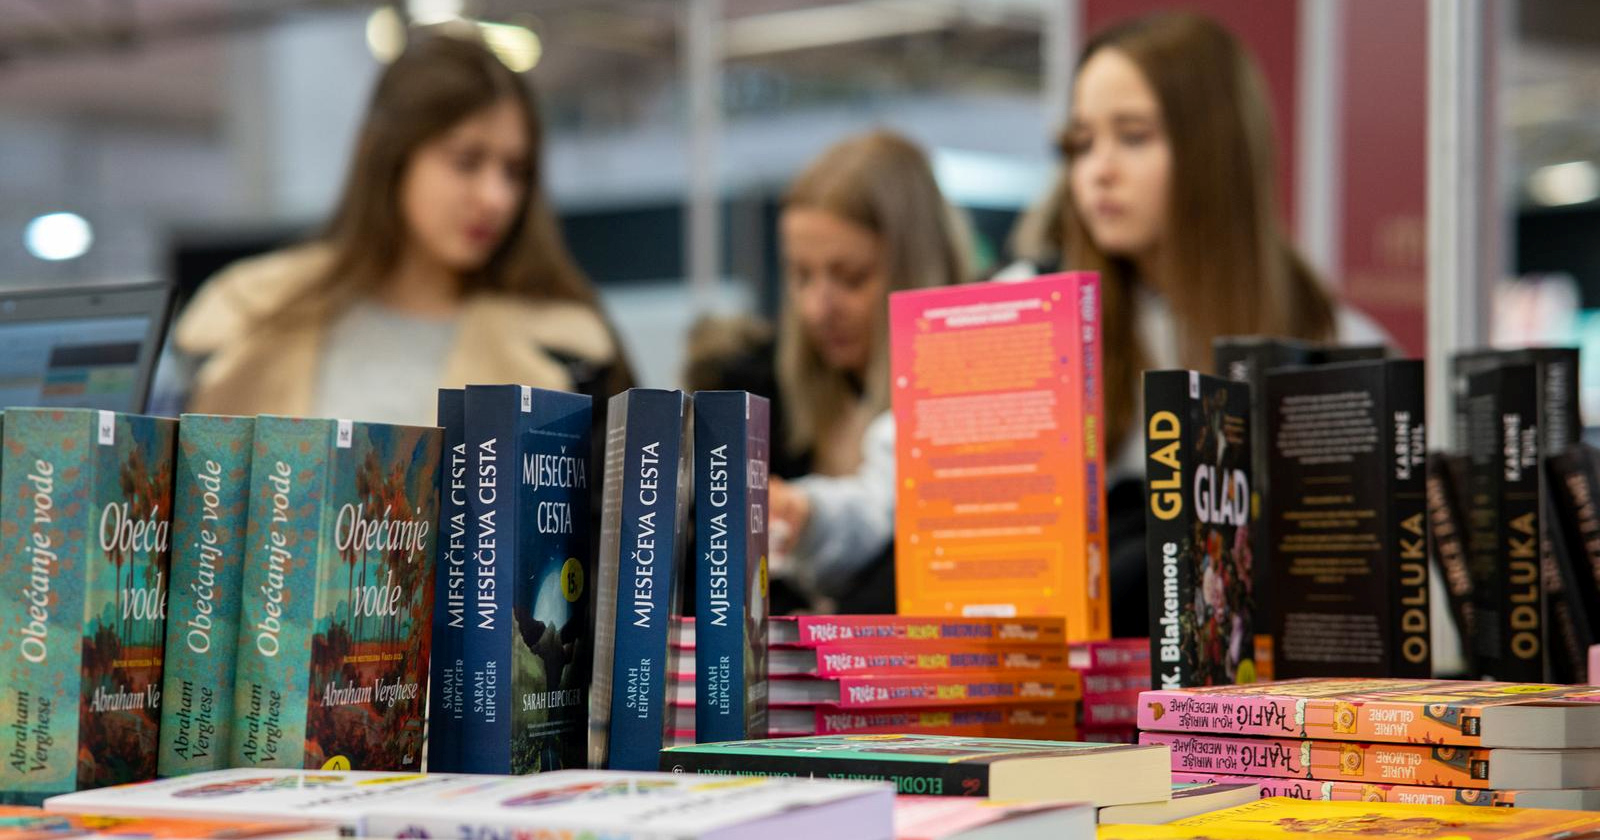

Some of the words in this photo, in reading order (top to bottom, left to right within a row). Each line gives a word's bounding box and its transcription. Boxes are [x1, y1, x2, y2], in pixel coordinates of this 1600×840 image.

[479, 438, 497, 505] CESTA
[522, 446, 587, 492] MJESEČEVA
[1149, 410, 1183, 521] GLAD
[1394, 410, 1411, 480] KARINE
[1503, 413, 1521, 481] KARINE
[27, 458, 54, 523] vode
[197, 459, 222, 525] vode
[267, 460, 292, 527] vode
[639, 441, 661, 507] CESTA
[710, 444, 728, 507] CESTA
[1193, 463, 1249, 526] GLAD
[99, 501, 168, 552] Obeća
[334, 502, 429, 563] Obećanje
[537, 501, 573, 536] CESTA
[21, 529, 58, 663] Obećanje
[186, 529, 223, 655] Obećanje
[256, 531, 292, 658] Obećanje
[354, 570, 401, 618] vode
[472, 510, 499, 630] MJESEČEVA
[631, 511, 657, 628] MJESEČEVA
[705, 512, 730, 627] MJESEČEVA
[1400, 513, 1427, 663] ODLUKA
[1508, 512, 1539, 659] ODLUKA
[1159, 541, 1180, 662] Blakemore
[840, 626, 853, 639] ZA
[442, 668, 454, 710] SARAH
[626, 667, 639, 709] SARAH
[638, 658, 652, 719] LEIPCIGER
[708, 665, 719, 707] SARAH
[719, 655, 731, 716] LEIPCIGER
[854, 656, 867, 668] ZA
[89, 685, 144, 713] Abraham
[320, 681, 371, 708] Abraham
[374, 676, 418, 708] Verghese
[473, 671, 485, 713] SARAH
[485, 660, 497, 723] LEIPCIGER
[522, 691, 546, 712] SARAH
[547, 688, 581, 708] LEIPCIGER
[877, 688, 889, 699] ZA
[1169, 698, 1218, 713] MEDENJAKE
[1222, 703, 1233, 714] NA
[1237, 701, 1294, 732] KAFIĆ
[1369, 709, 1414, 723] GILMORE
[9, 690, 30, 774] Abraham
[30, 695, 53, 774] Verghese
[174, 679, 194, 761] Abraham
[193, 685, 215, 759] Verghese
[242, 682, 263, 764] Abraham
[261, 689, 282, 764] Verghese
[1172, 738, 1222, 755] MEDENJAKE
[1179, 713, 1209, 729] MIRIŠE
[1212, 715, 1232, 729] KOJI
[1374, 722, 1408, 736] LAURIE
[1182, 754, 1212, 769] MIRIŠE
[1216, 756, 1237, 769] KOJI
[1226, 744, 1237, 755] NA
[1241, 742, 1300, 773] KAFIĆ
[1376, 751, 1422, 766] GILMORE
[1381, 766, 1415, 779] LAURIE
[891, 776, 943, 795] ELODIE
